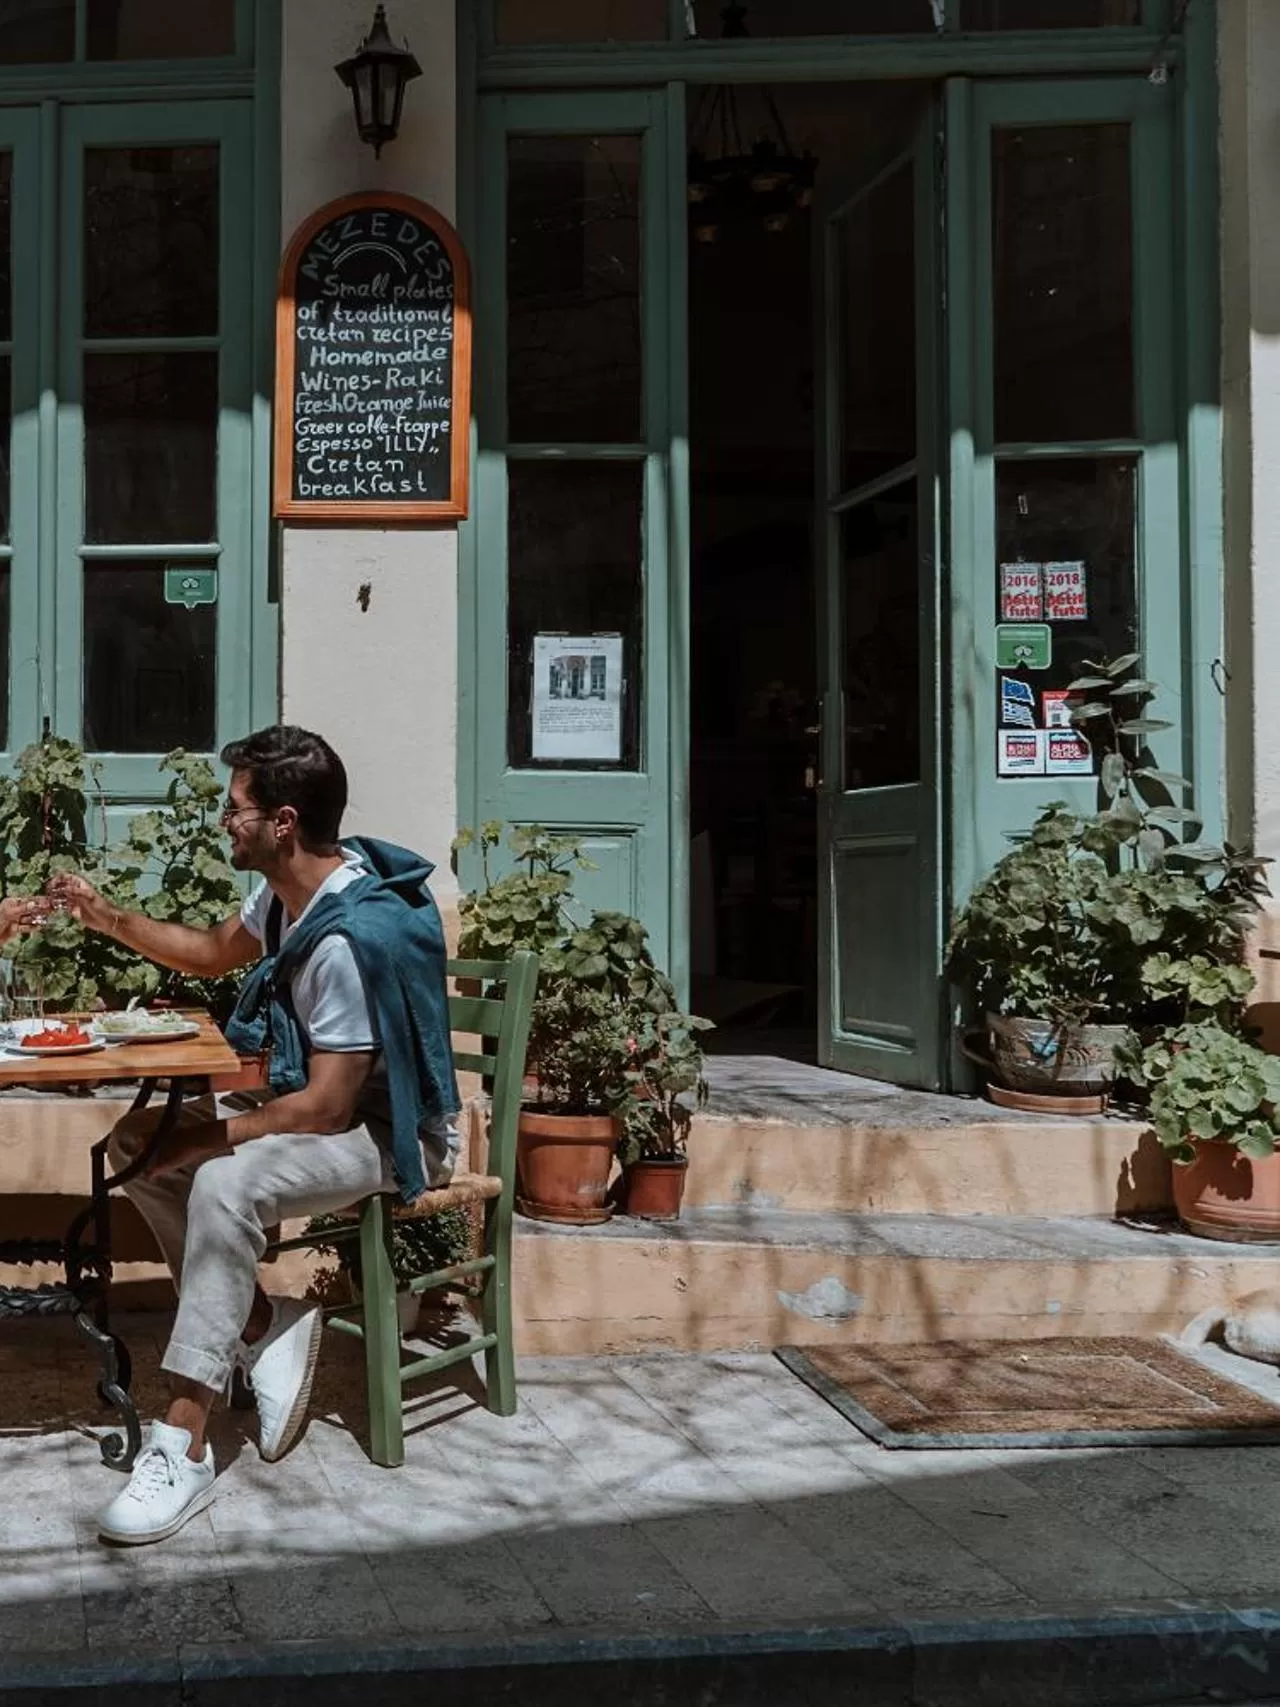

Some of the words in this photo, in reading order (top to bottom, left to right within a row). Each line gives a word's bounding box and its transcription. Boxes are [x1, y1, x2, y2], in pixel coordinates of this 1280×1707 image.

[301, 213, 451, 281] MEZEDES
[322, 273, 391, 296] Small
[393, 273, 453, 304] plates
[297, 300, 324, 321] of
[332, 301, 453, 323] traditional
[371, 324, 453, 349] recipes
[310, 345, 448, 368] Homemade
[307, 454, 404, 474] Cretan
[298, 470, 427, 496] breakfast
[1007, 575, 1037, 587] 2016
[1048, 573, 1080, 586] 2018
